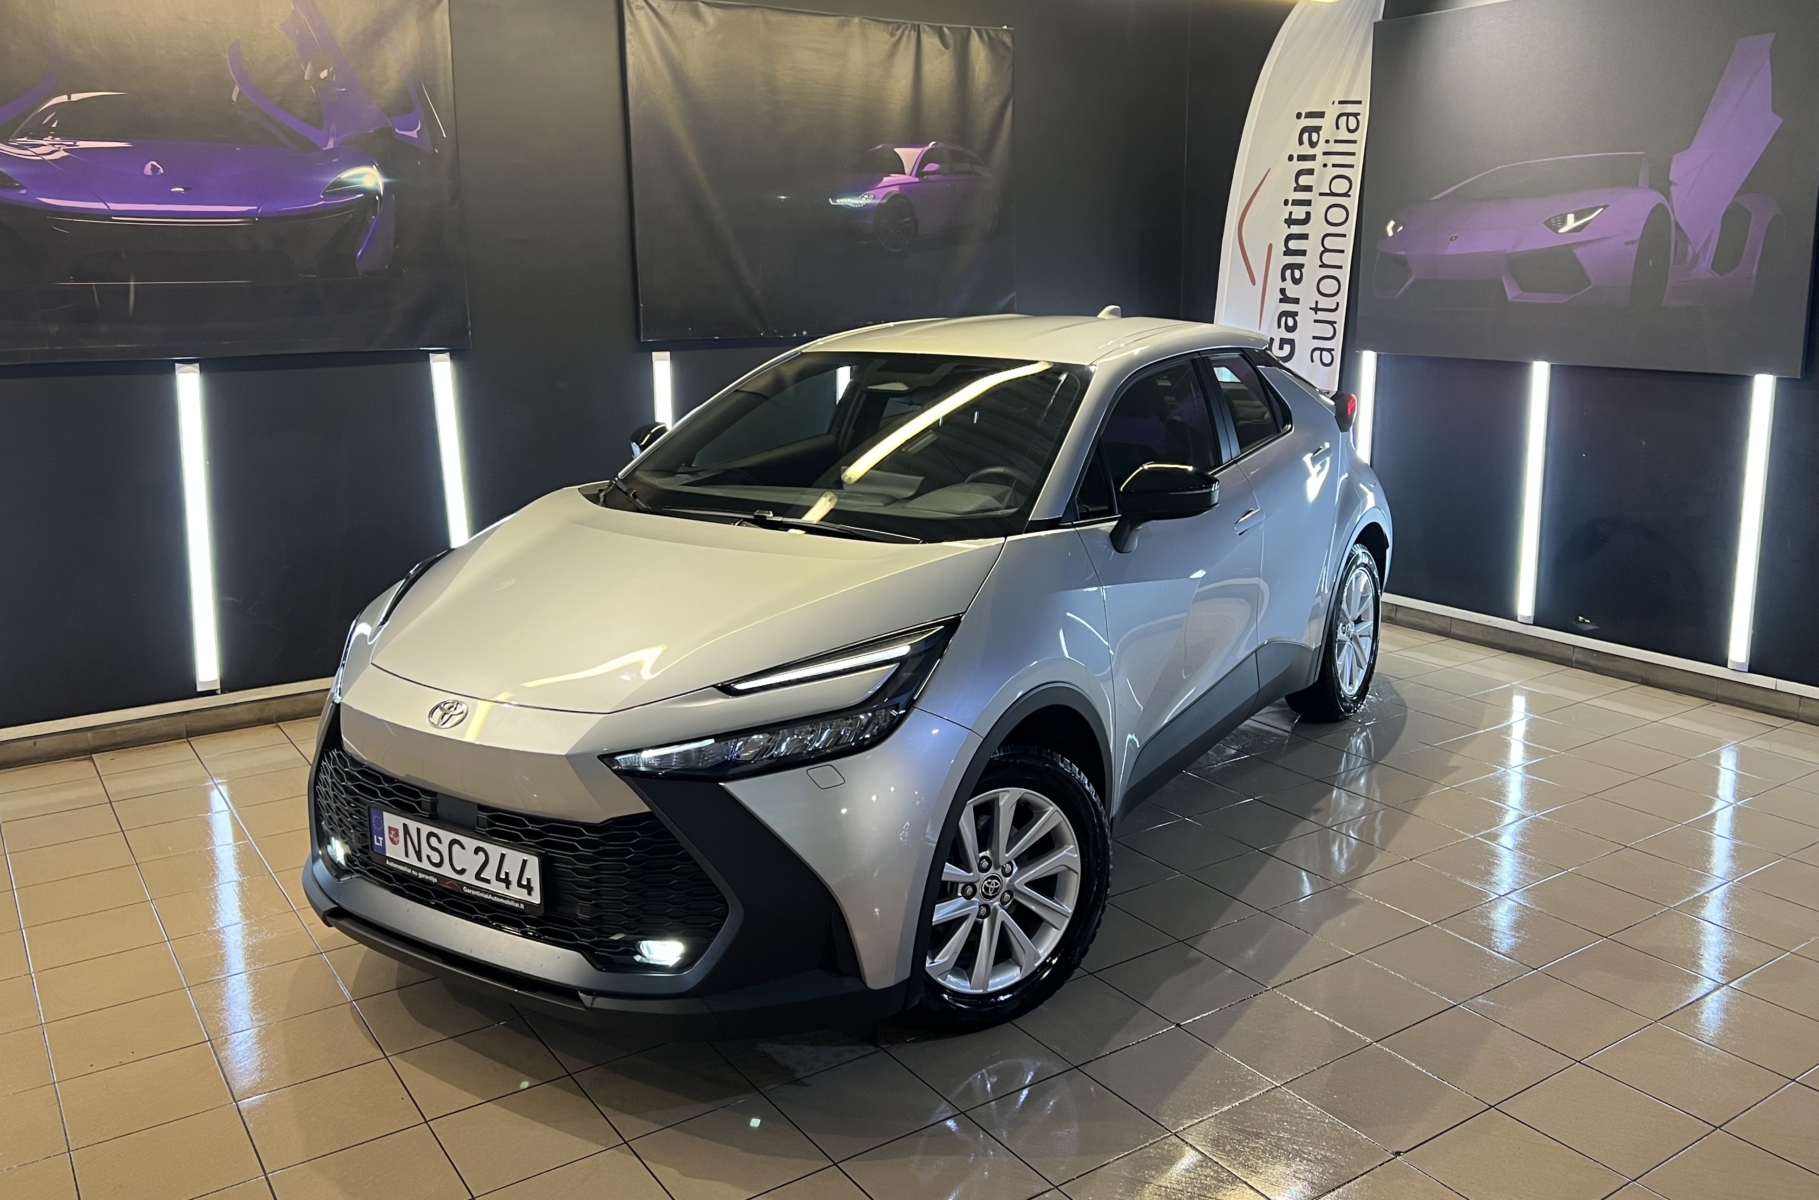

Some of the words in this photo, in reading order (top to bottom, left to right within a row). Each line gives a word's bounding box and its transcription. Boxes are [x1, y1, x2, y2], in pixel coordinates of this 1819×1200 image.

[1268, 110, 1326, 364] Garantiniai
[1309, 99, 1363, 367] automobiliai
[373, 834, 384, 847] LT
